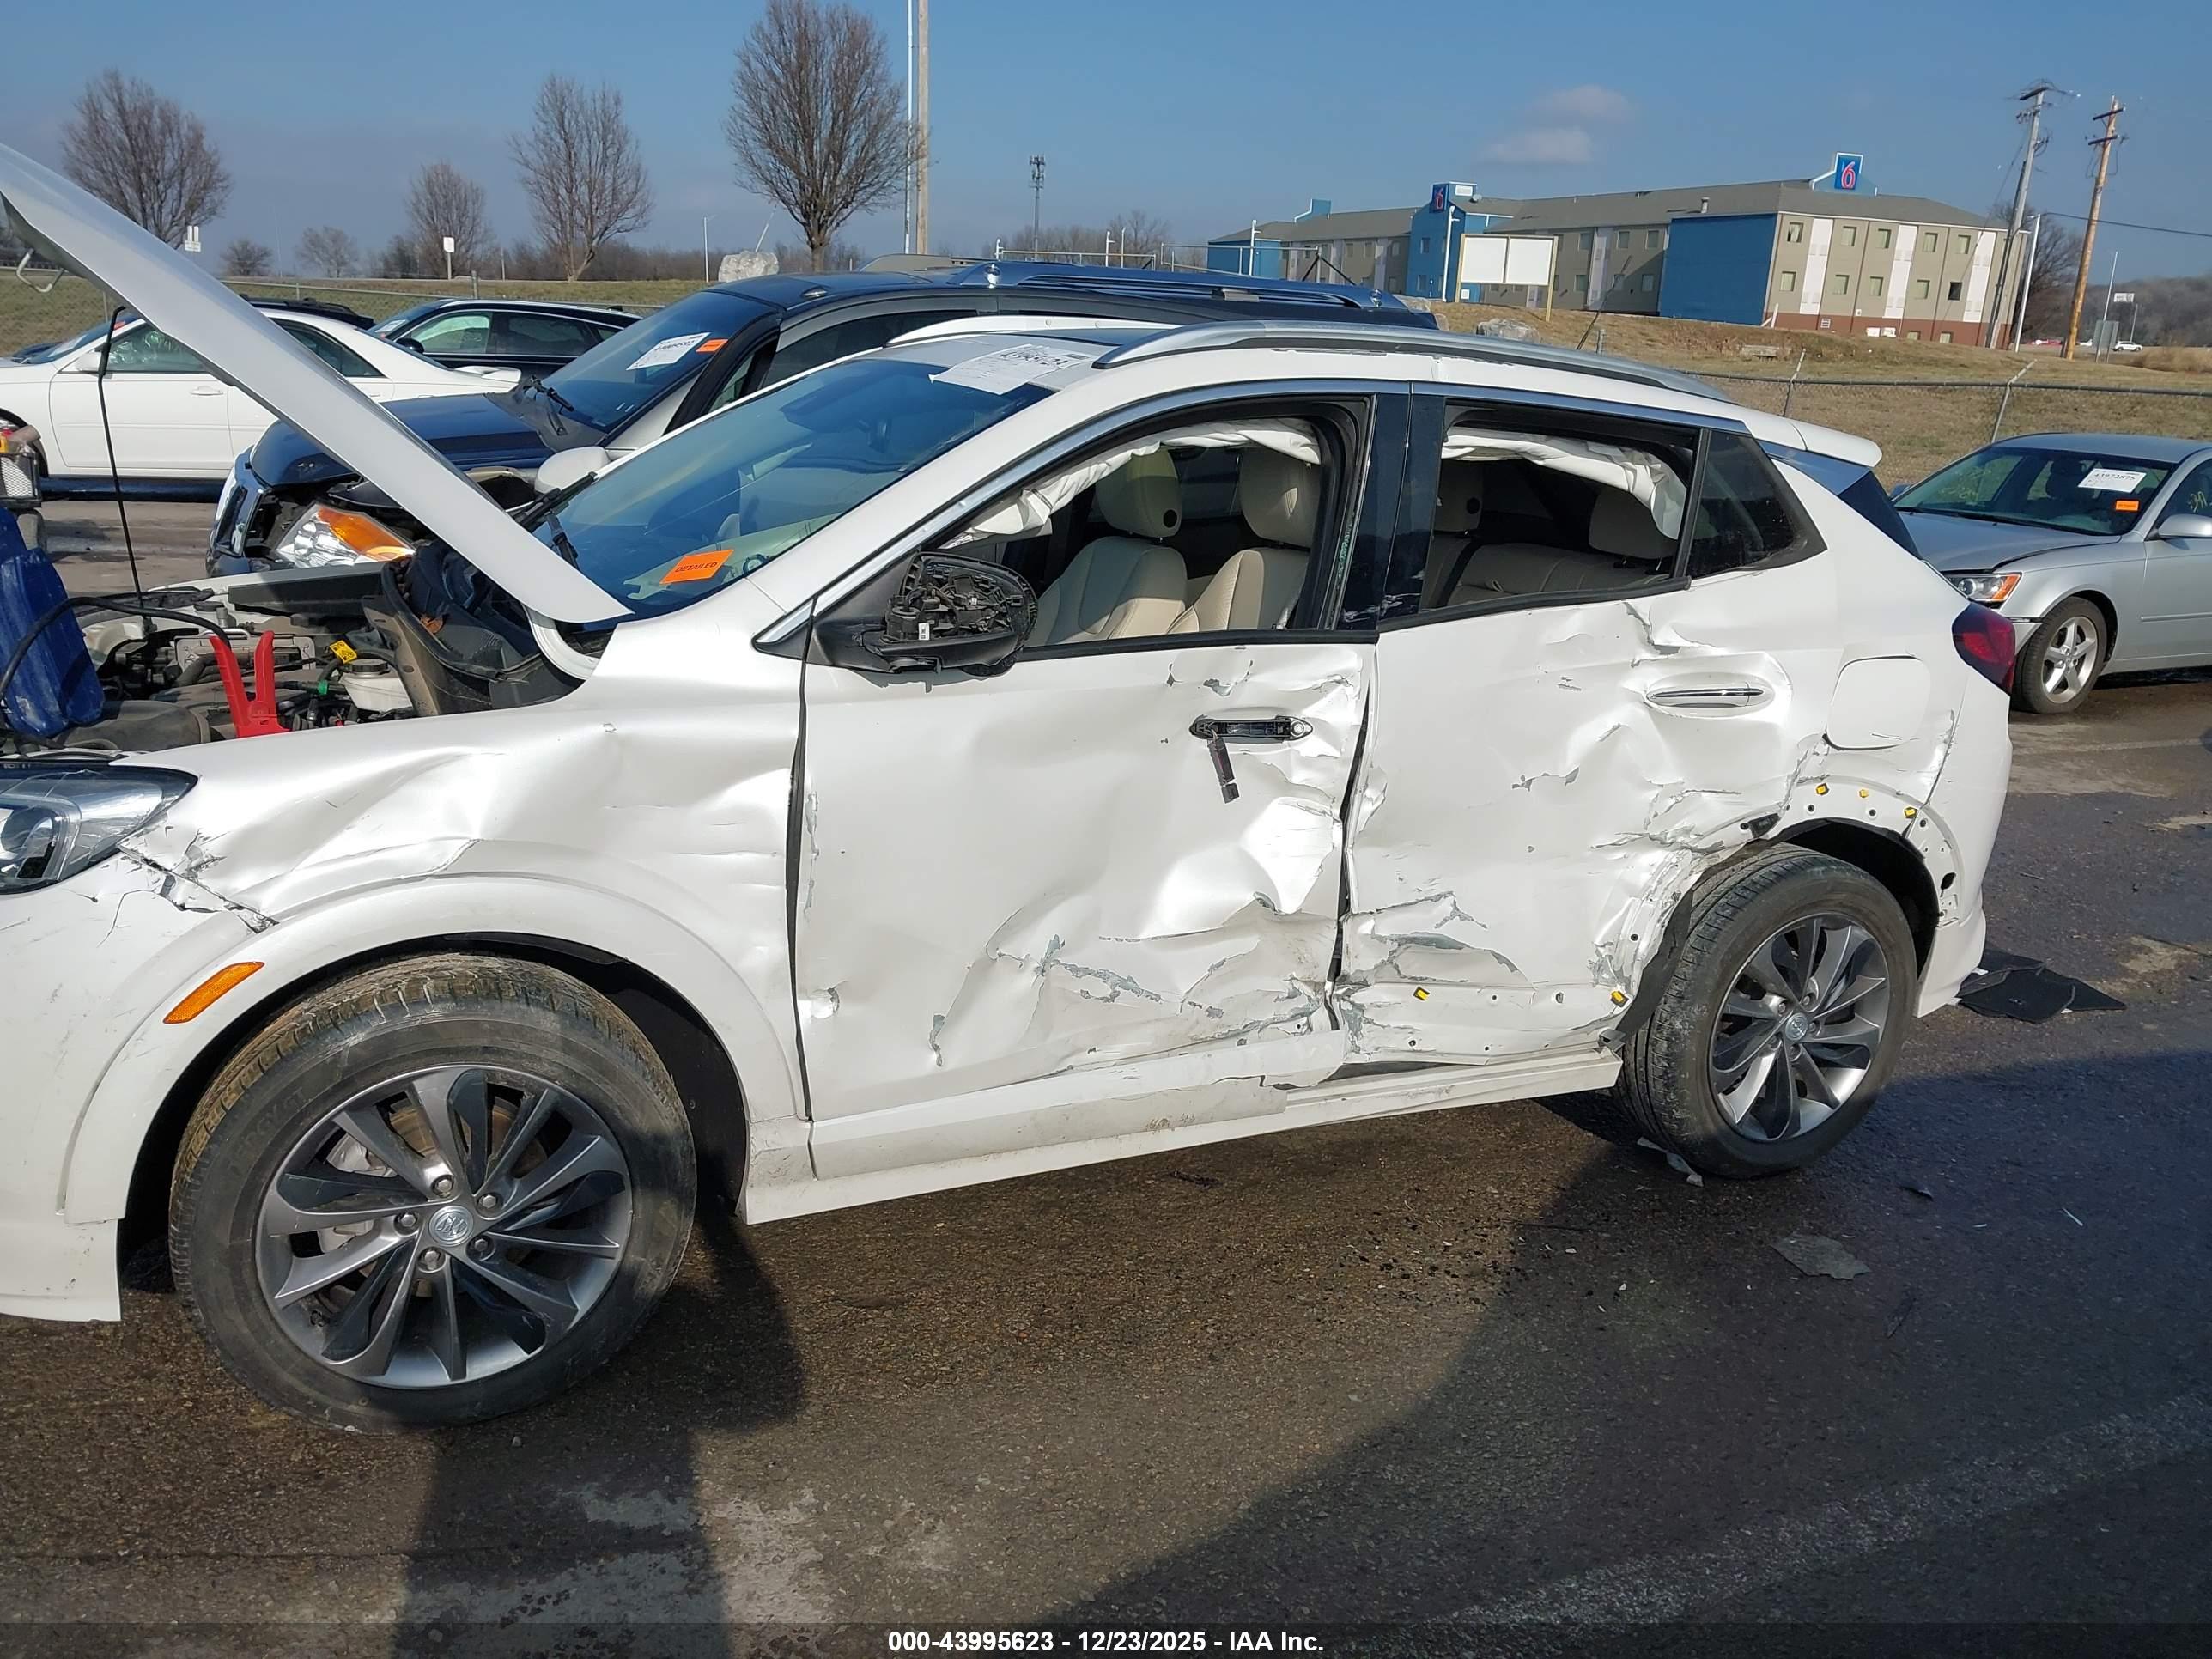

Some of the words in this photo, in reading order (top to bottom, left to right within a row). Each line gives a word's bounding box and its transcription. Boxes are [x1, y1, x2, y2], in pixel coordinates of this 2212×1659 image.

[1841, 161, 1856, 190] 6
[1436, 187, 1444, 210] 6
[674, 561, 718, 573] DETAILED
